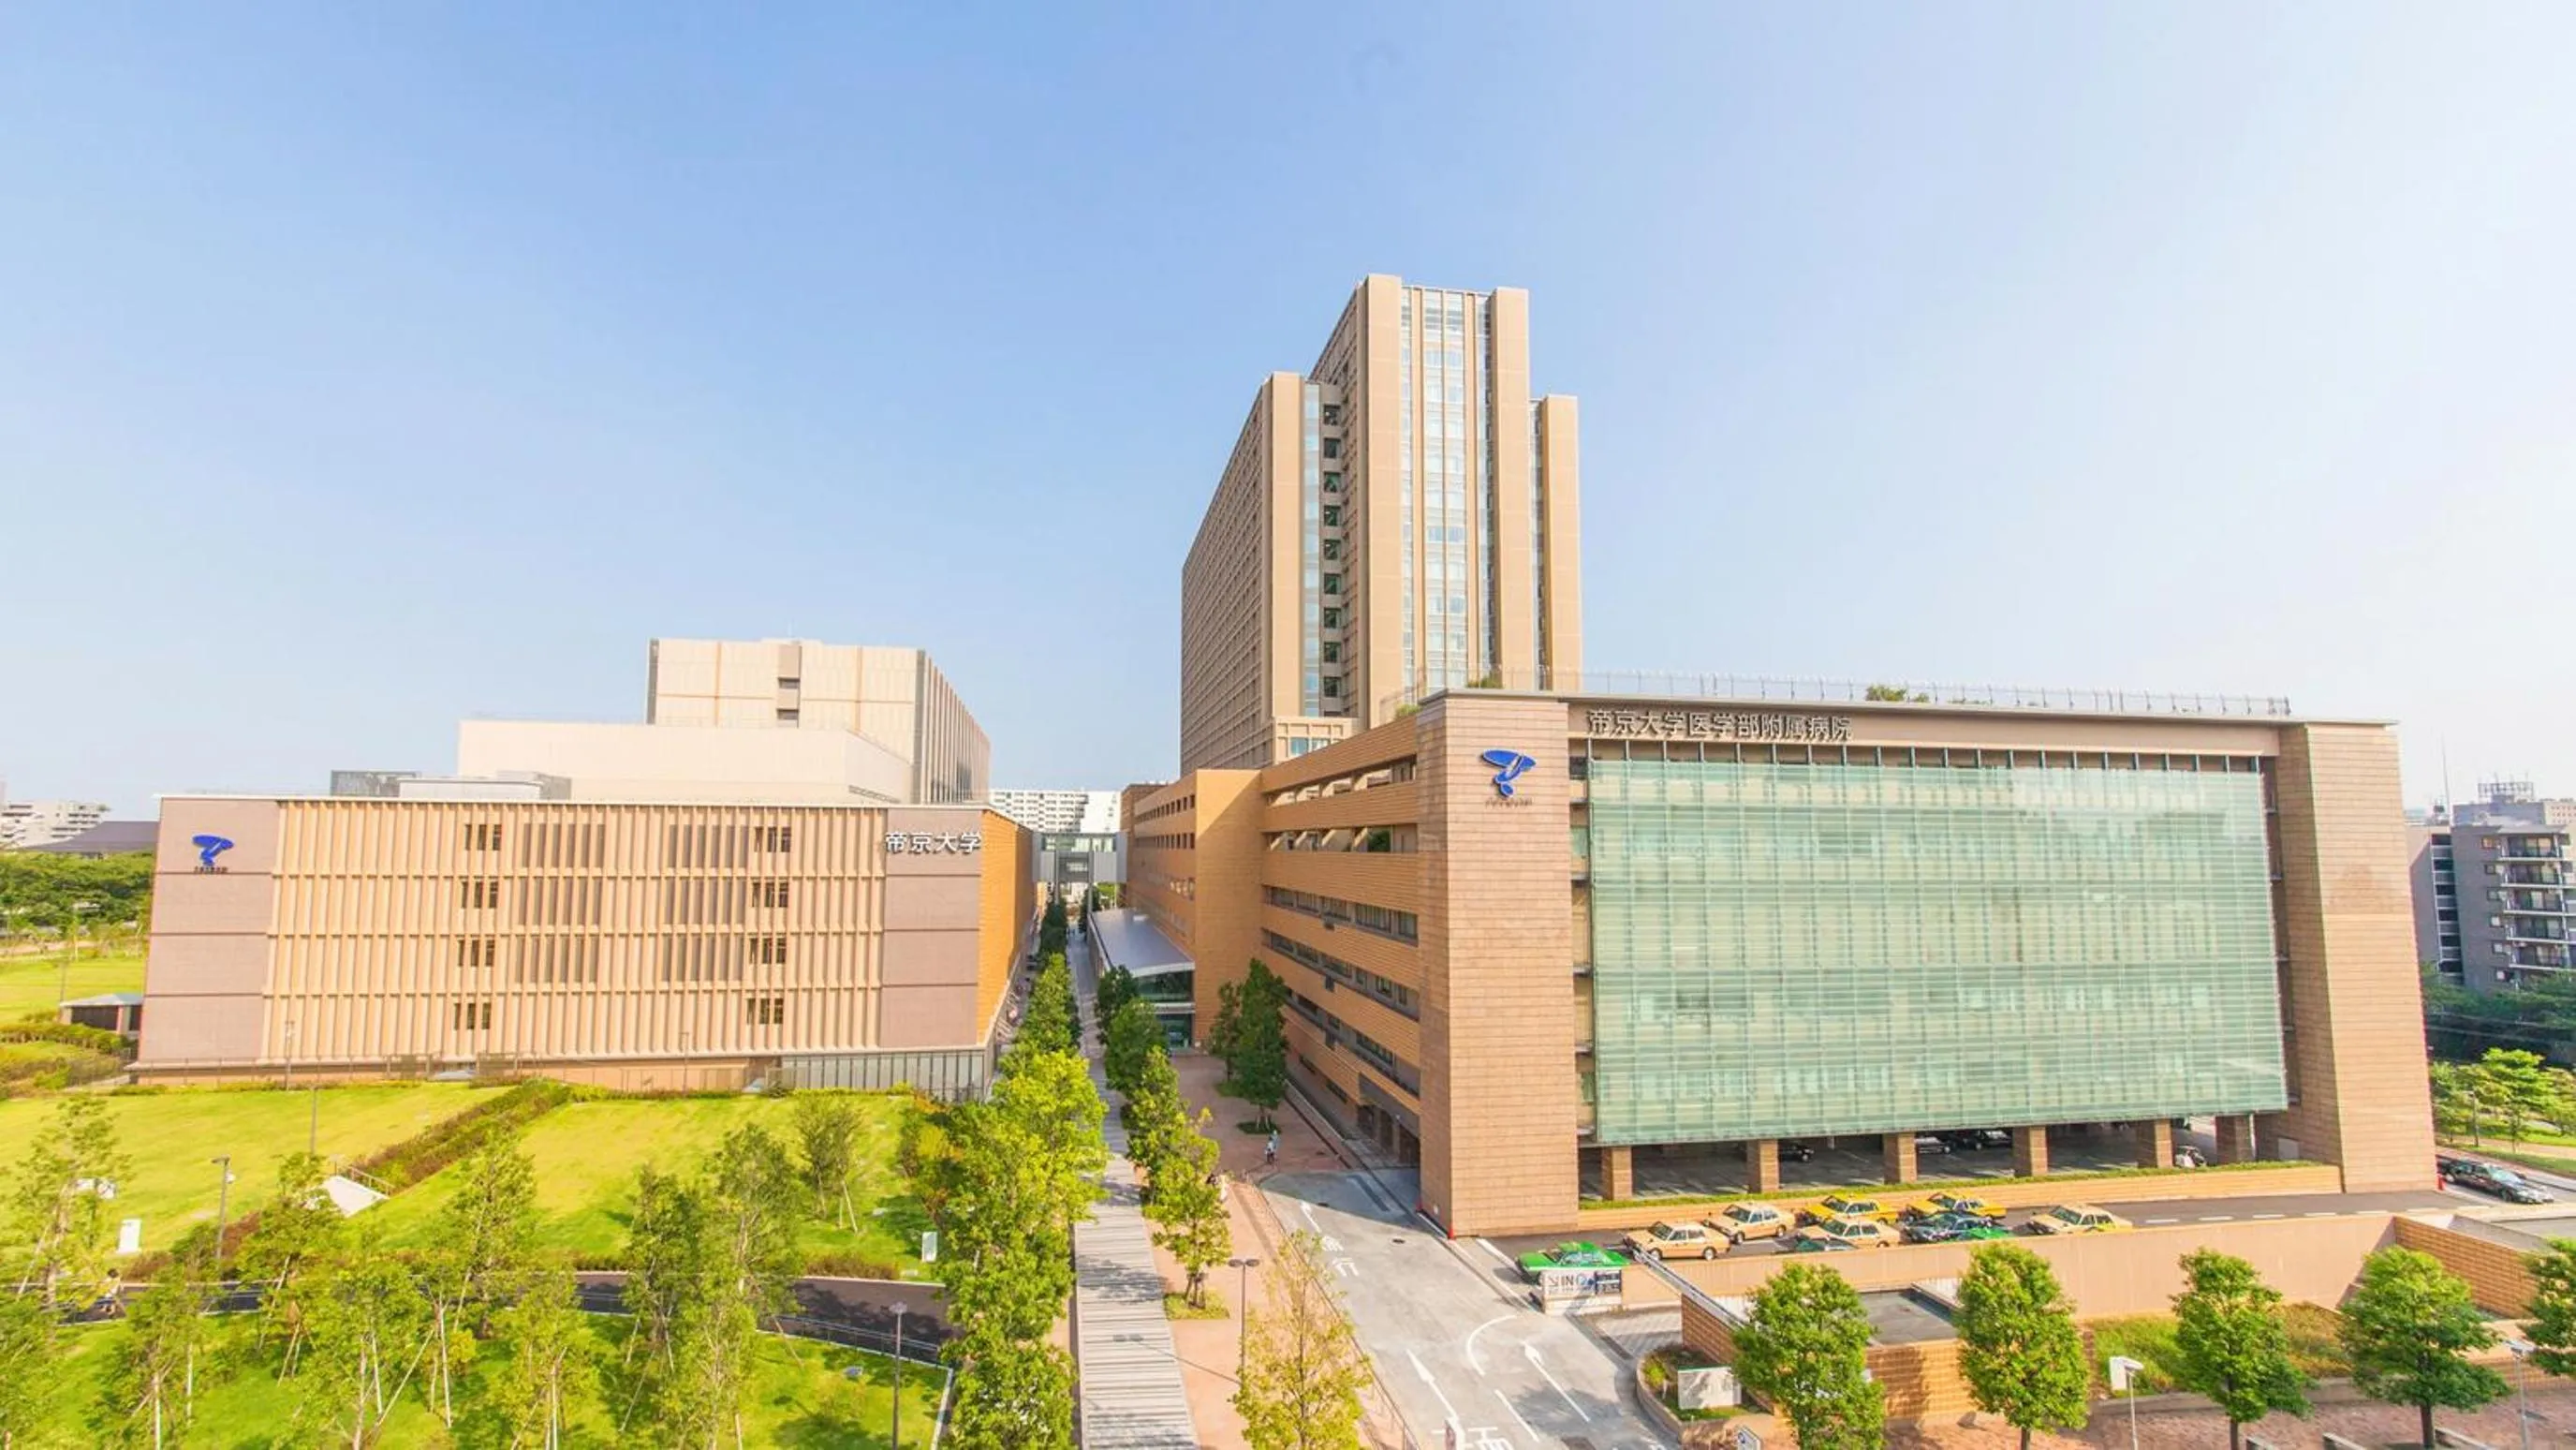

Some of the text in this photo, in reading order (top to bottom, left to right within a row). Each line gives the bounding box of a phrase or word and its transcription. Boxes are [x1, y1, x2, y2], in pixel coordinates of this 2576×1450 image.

[1589, 709, 1853, 740] 帝京大学医学部附属病院
[885, 831, 982, 853] 帝京大学
